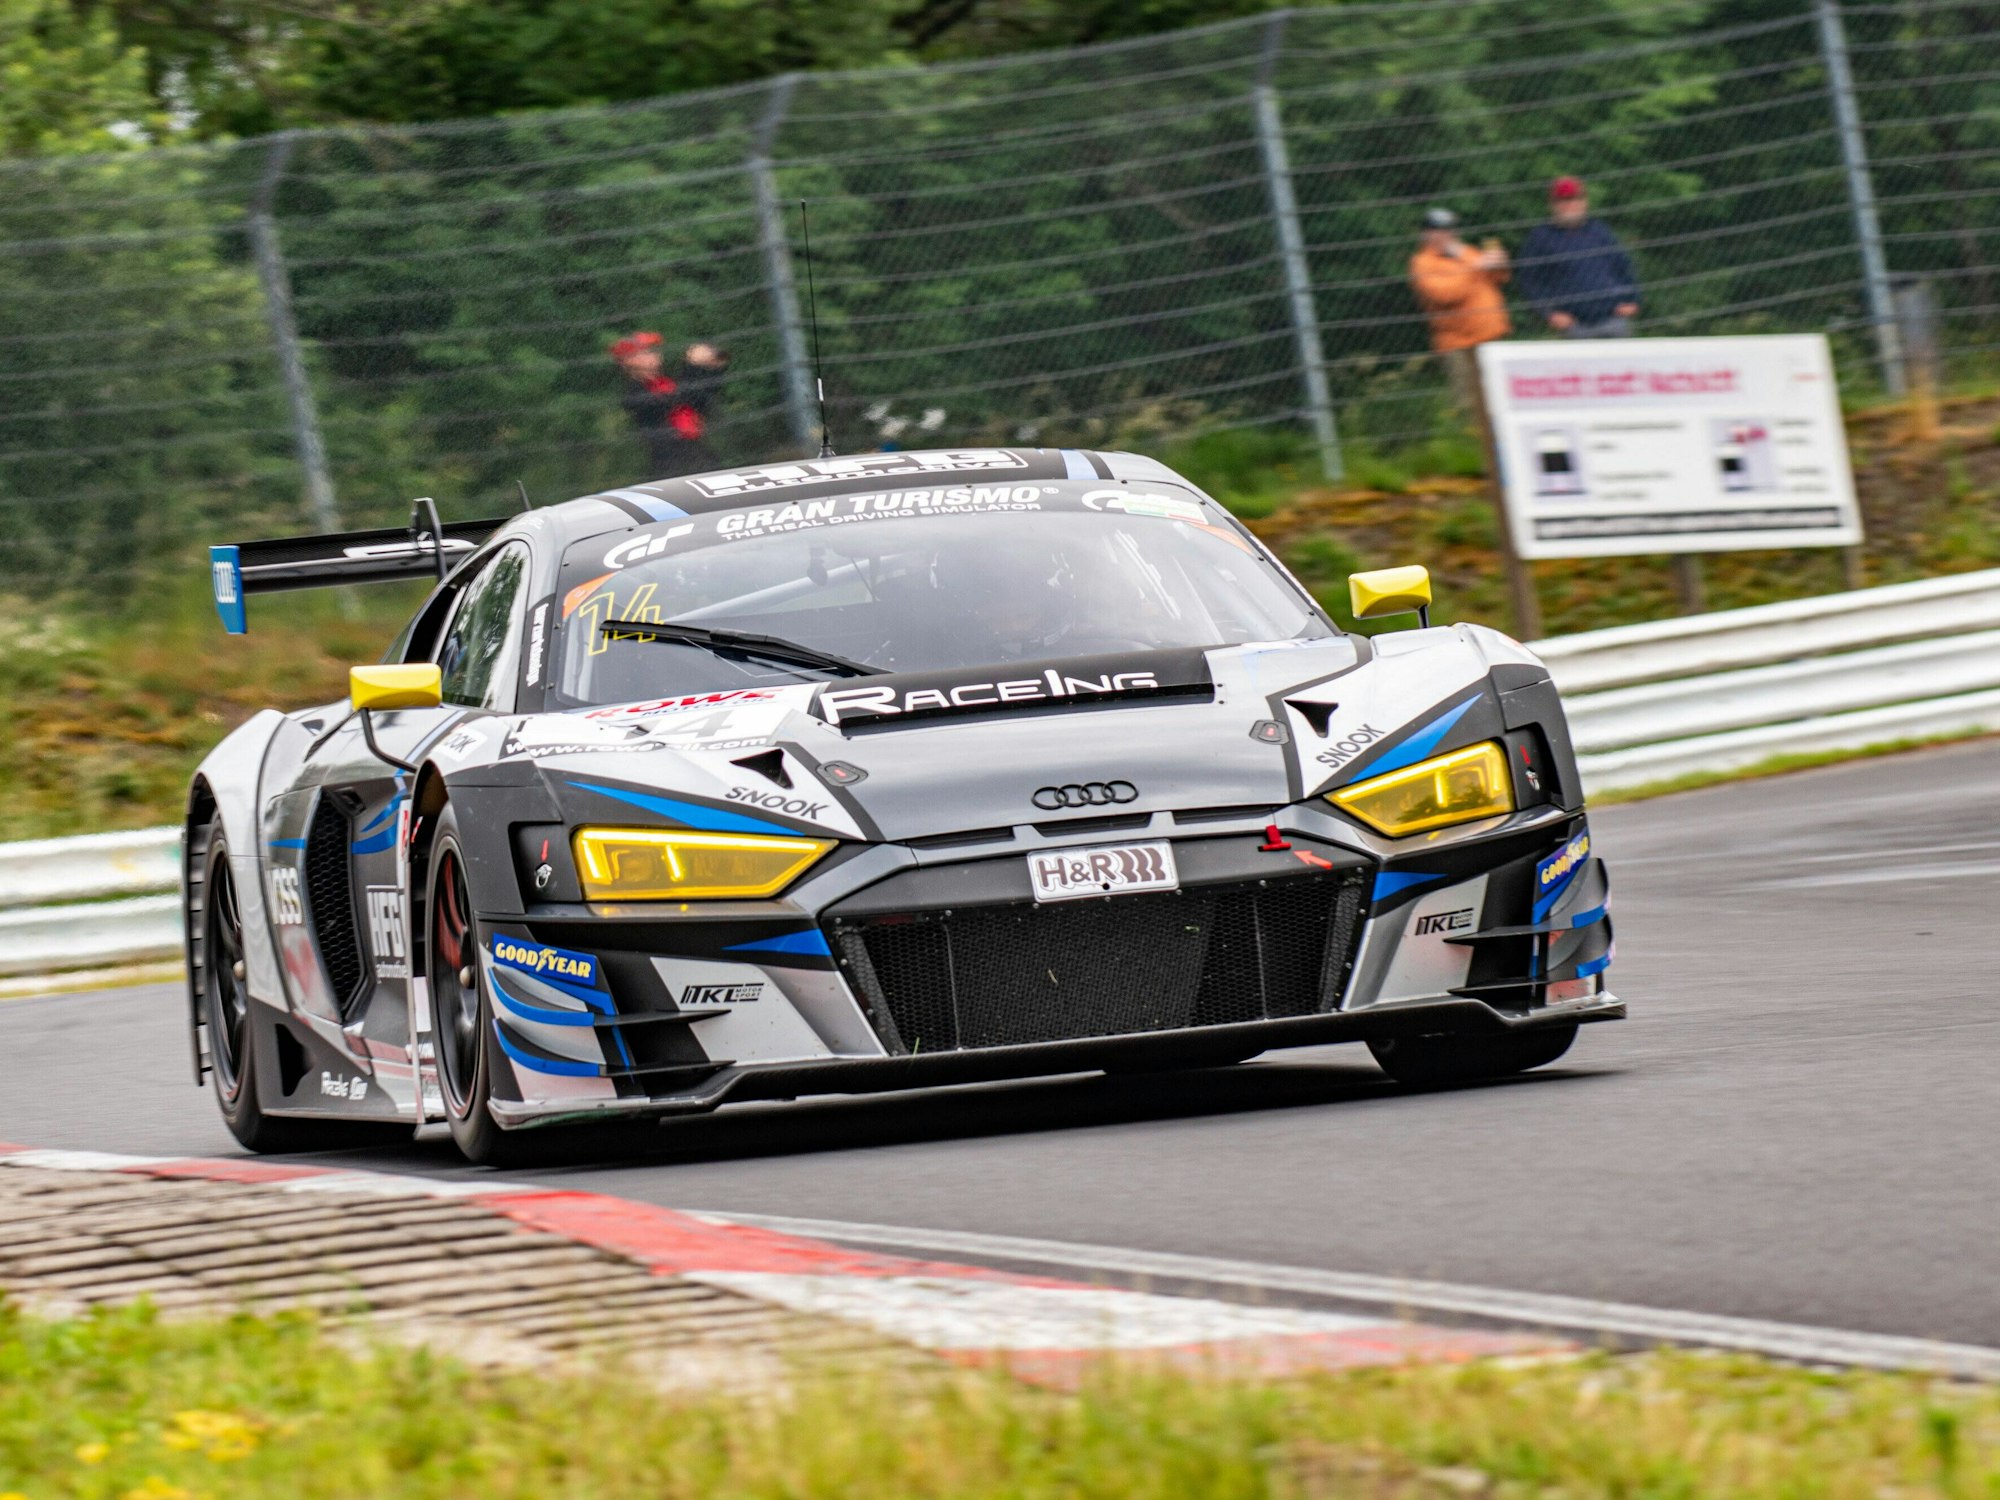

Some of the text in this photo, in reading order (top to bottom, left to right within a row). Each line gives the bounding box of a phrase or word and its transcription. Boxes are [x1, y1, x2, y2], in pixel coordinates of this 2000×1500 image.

[716, 498, 836, 535] GRAN
[722, 502, 1041, 541] THE REAL DRIVING SIMULATOR
[578, 583, 665, 656] 14
[584, 689, 784, 719] ROWE
[1316, 724, 1385, 769] SNOOK
[724, 786, 832, 821] SNOOK
[1037, 853, 1118, 889] H&R
[495, 942, 592, 978] GOODYEAR
